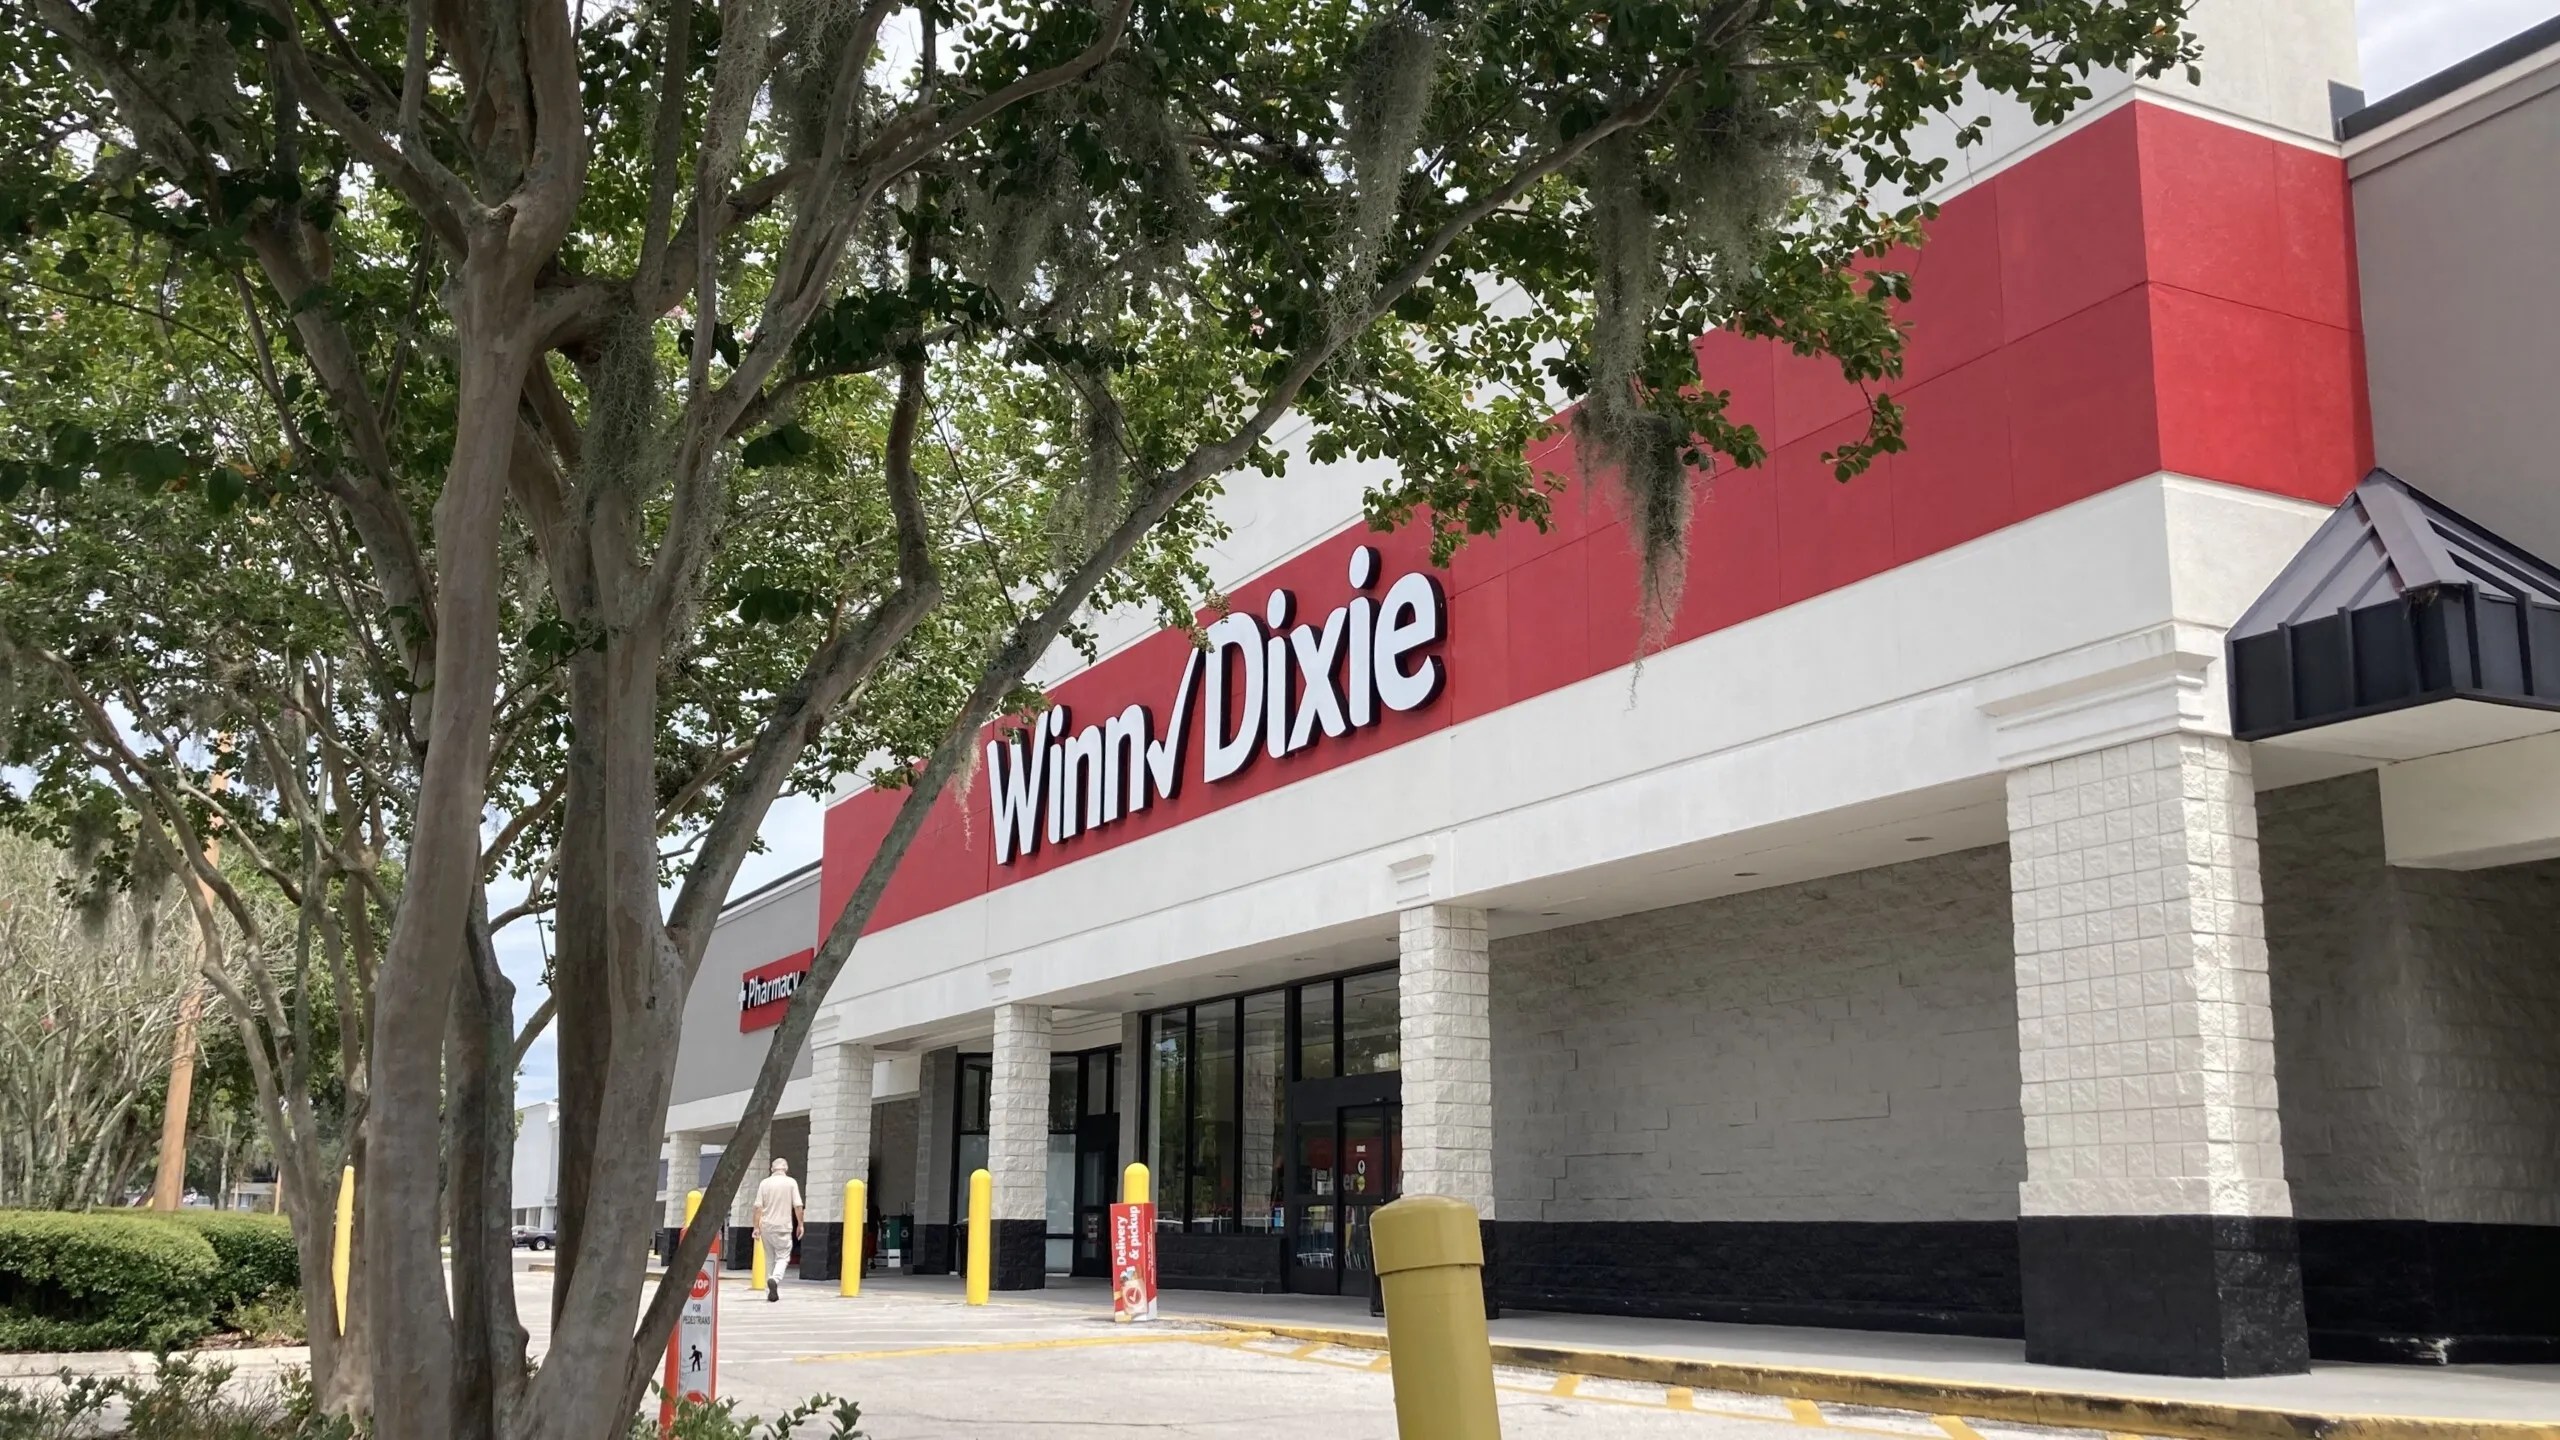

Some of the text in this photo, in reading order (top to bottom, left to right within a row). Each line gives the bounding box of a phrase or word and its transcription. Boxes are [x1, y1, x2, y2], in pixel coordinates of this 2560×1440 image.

[986, 545, 1445, 865] Winn Dixie
[747, 971, 801, 1009] Pharmacy
[1116, 1216, 1128, 1266] Delivery
[1128, 1205, 1141, 1260] & pickup
[693, 1279, 709, 1289] TOP
[683, 1315, 711, 1325] PEDESTRIANS
[692, 1304, 701, 1312] FOR
